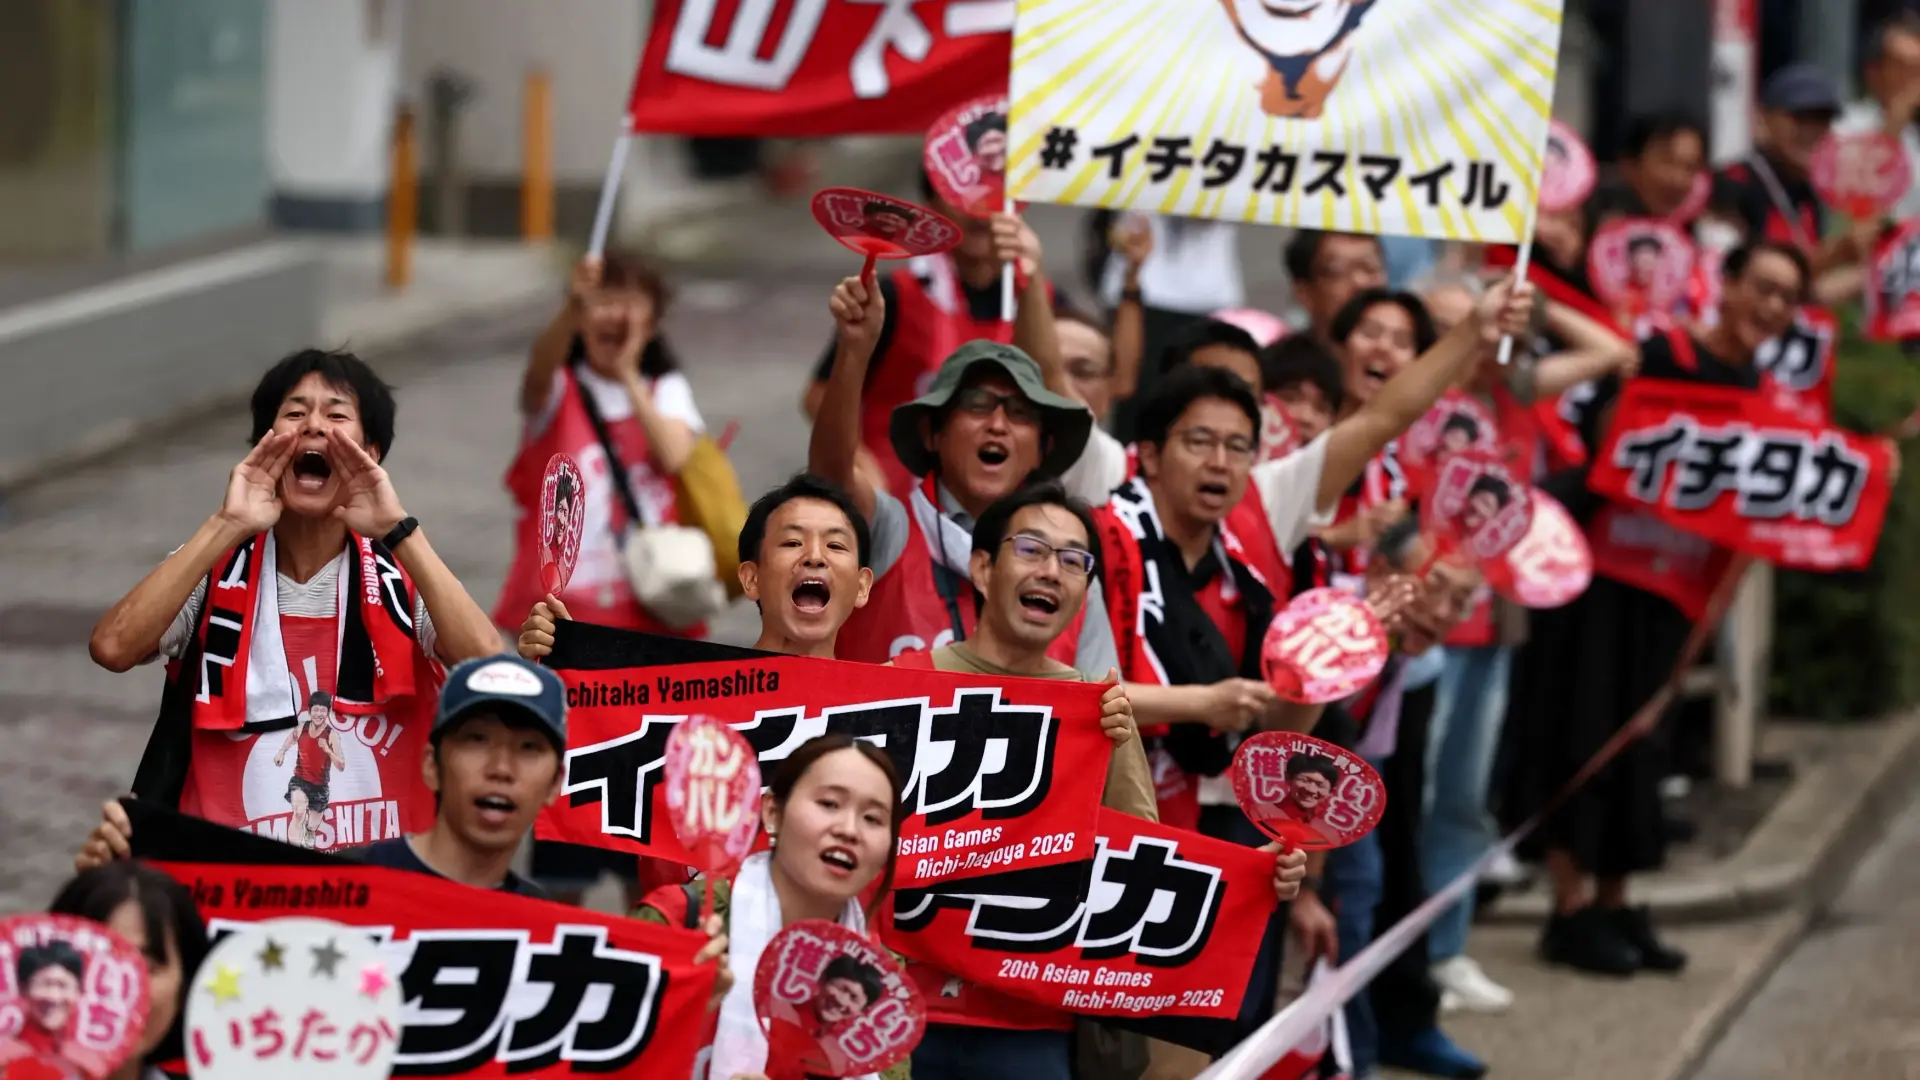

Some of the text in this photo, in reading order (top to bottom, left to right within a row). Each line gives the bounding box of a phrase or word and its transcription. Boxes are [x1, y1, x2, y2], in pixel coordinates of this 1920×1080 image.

[1612, 412, 1870, 527] イチタカ
[566, 668, 780, 708] chitaka Yamashita
[914, 832, 1075, 879] Aichi-Nagoya 2026
[943, 826, 1003, 850] Games
[233, 878, 370, 909] Yamashita
[998, 959, 1153, 988] 20th Asian Games
[1062, 988, 1225, 1012] Aichi-Nagoya 2026
[192, 1007, 398, 1068] いちたか
